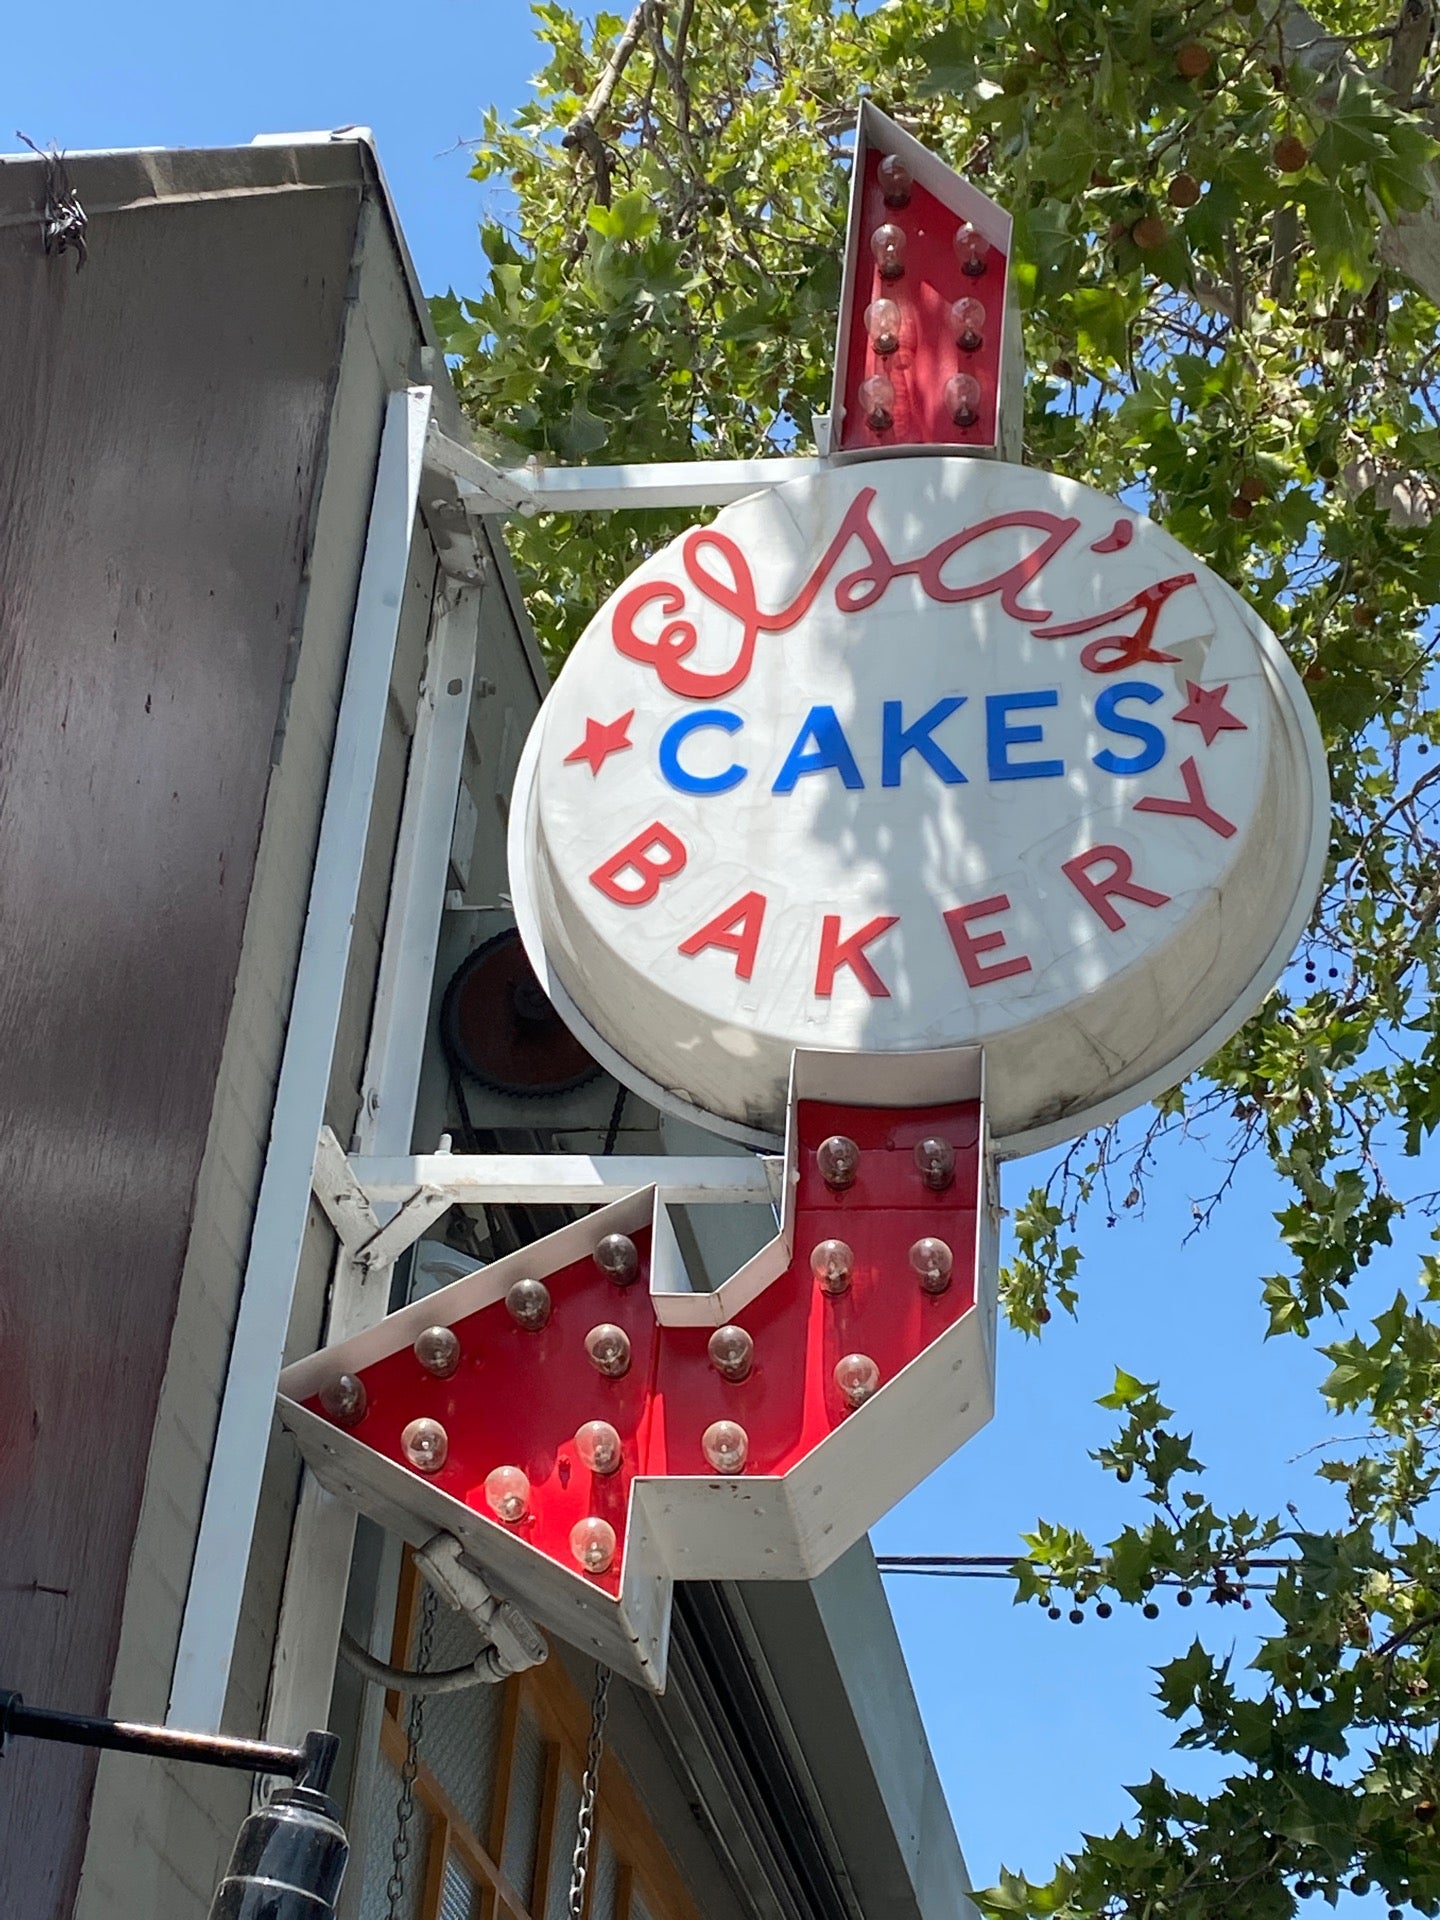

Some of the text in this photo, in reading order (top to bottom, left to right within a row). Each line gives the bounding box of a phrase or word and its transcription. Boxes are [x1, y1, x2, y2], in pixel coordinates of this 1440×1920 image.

[611, 487, 1197, 700] Elsa's
[658, 681, 1167, 795] CAKES
[589, 756, 1238, 998] BAKERY
